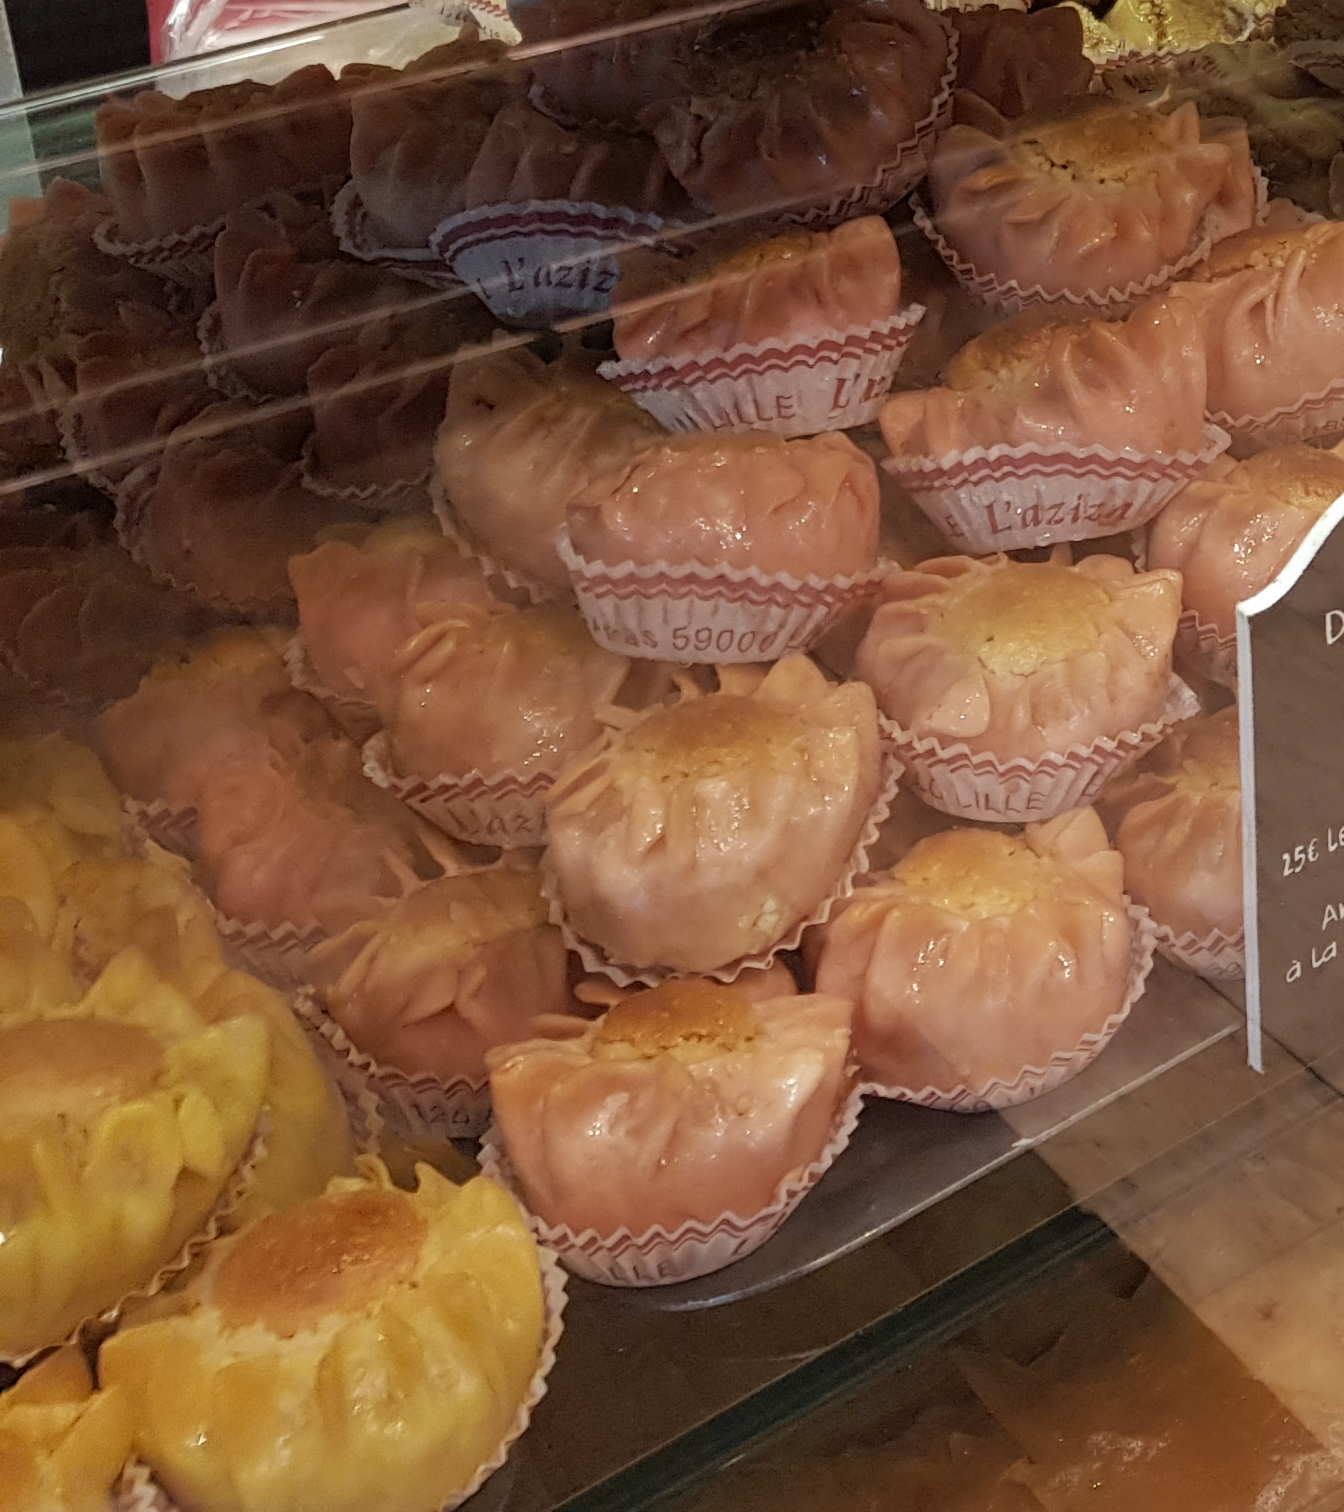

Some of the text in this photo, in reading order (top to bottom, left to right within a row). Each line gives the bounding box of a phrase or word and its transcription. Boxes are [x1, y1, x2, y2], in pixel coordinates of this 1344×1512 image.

[500, 257, 617, 293] L'aziz
[985, 490, 1134, 537] L'aziza
[1285, 959, 1303, 983] à
